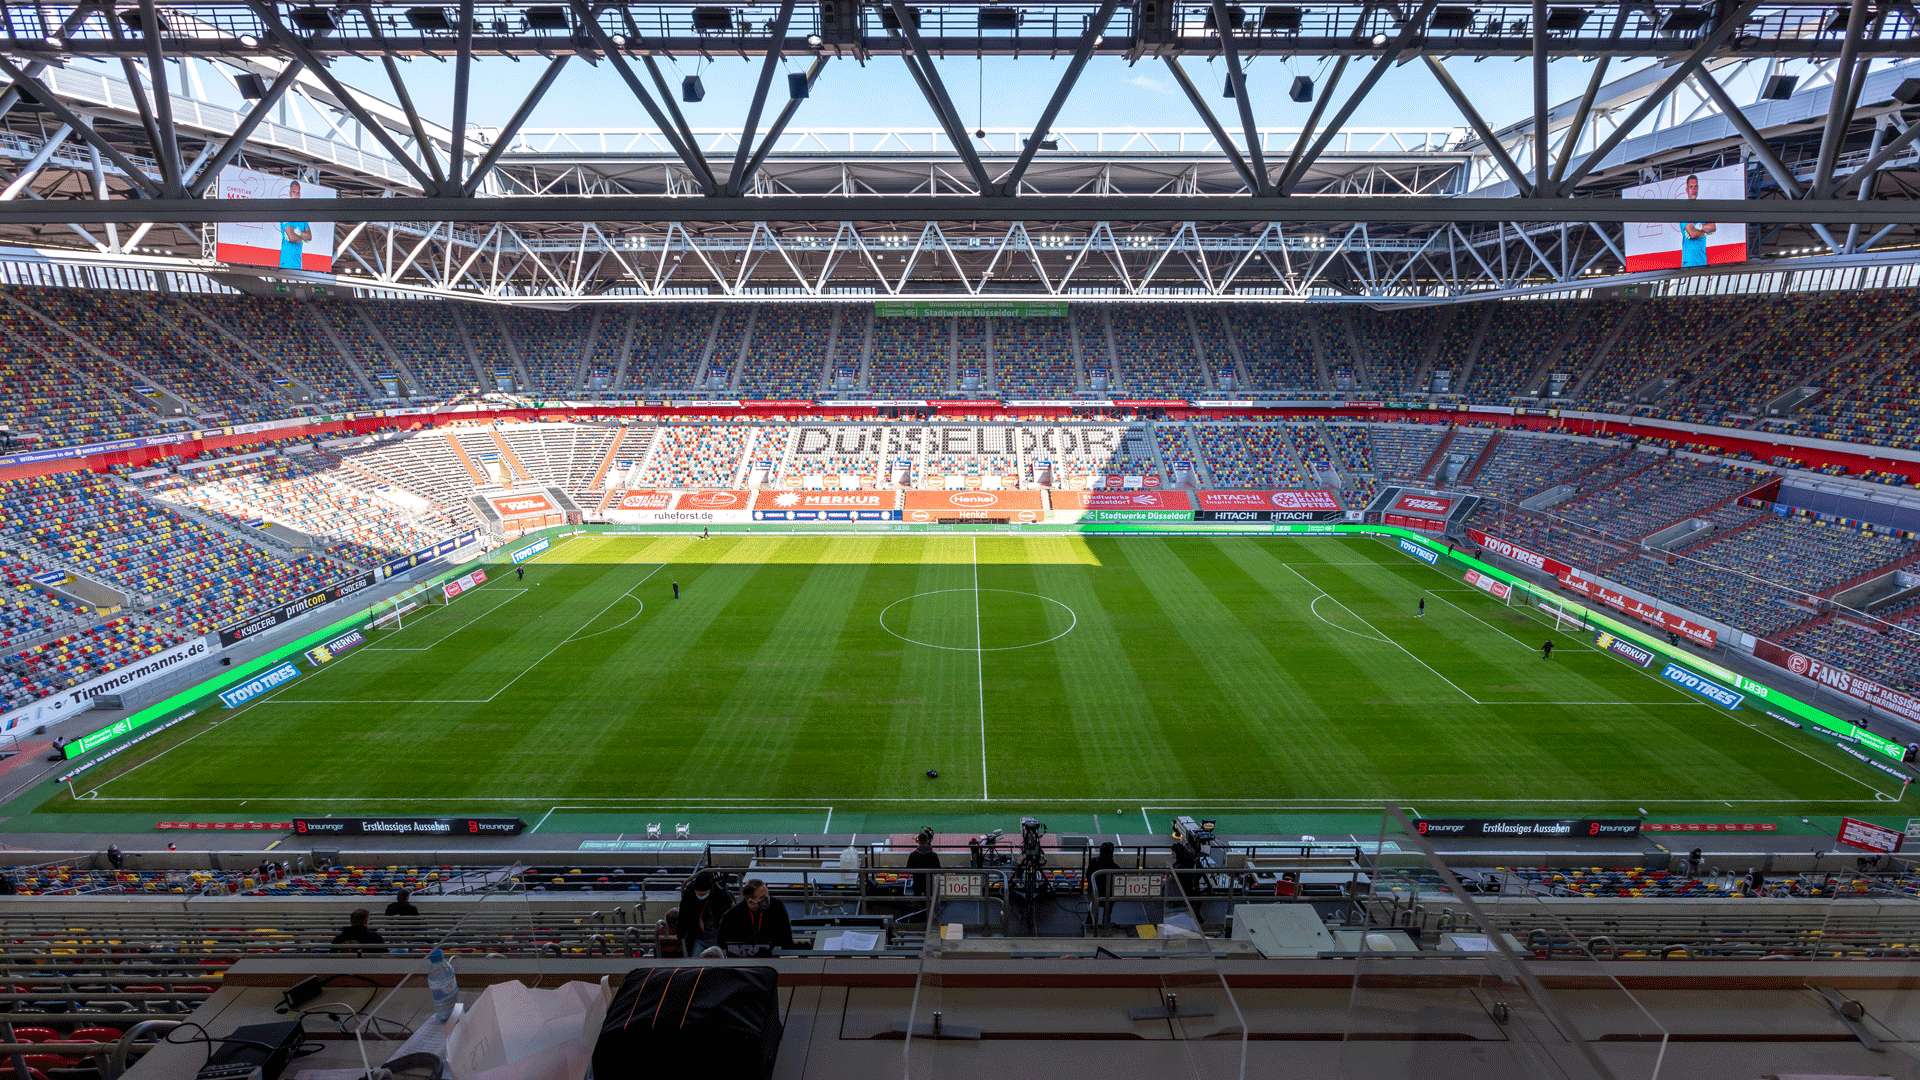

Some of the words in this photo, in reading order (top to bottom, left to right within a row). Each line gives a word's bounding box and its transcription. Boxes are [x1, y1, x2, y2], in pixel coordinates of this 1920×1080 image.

[924, 308, 973, 316] Stadtwerke
[974, 308, 1018, 316] Düsseldorf
[798, 428, 1144, 454] DÜSSELDORF
[805, 496, 880, 504] MERKUR
[654, 511, 713, 520] ruheforst.de
[1100, 511, 1147, 520] Stadtwerke
[1148, 511, 1191, 520] Düsseldorf
[1215, 512, 1258, 520] HITACHI
[1270, 512, 1313, 520] HITACHI
[514, 548, 532, 560] TOYO
[1400, 540, 1416, 554] TOYO
[1416, 547, 1435, 562] TIRES
[1484, 536, 1511, 556] TOYO
[1510, 548, 1546, 569] TIRES
[286, 593, 326, 618] printcom
[240, 616, 276, 637] KYOCERA
[329, 632, 362, 652] MERKUR
[1613, 641, 1648, 662] MERKUR
[70, 643, 205, 704] Timmermanns.de
[1808, 662, 1850, 691] FANS
[226, 681, 261, 704] TOYO
[261, 664, 297, 688] TIRES
[1664, 666, 1697, 687] TOYO
[1696, 679, 1737, 705] TIRES
[1850, 686, 1865, 698] UND
[308, 822, 345, 832] breuninger
[363, 821, 412, 832] Erstklassiges
[414, 821, 450, 832] Aussehen
[478, 822, 515, 832] breuninger
[1428, 823, 1465, 833] breuninger
[1483, 822, 1532, 834] Erstklassiges
[1533, 823, 1570, 833] Aussehen
[1600, 824, 1636, 833] breuninger
[949, 883, 968, 894] 106
[1129, 884, 1147, 894] 105
